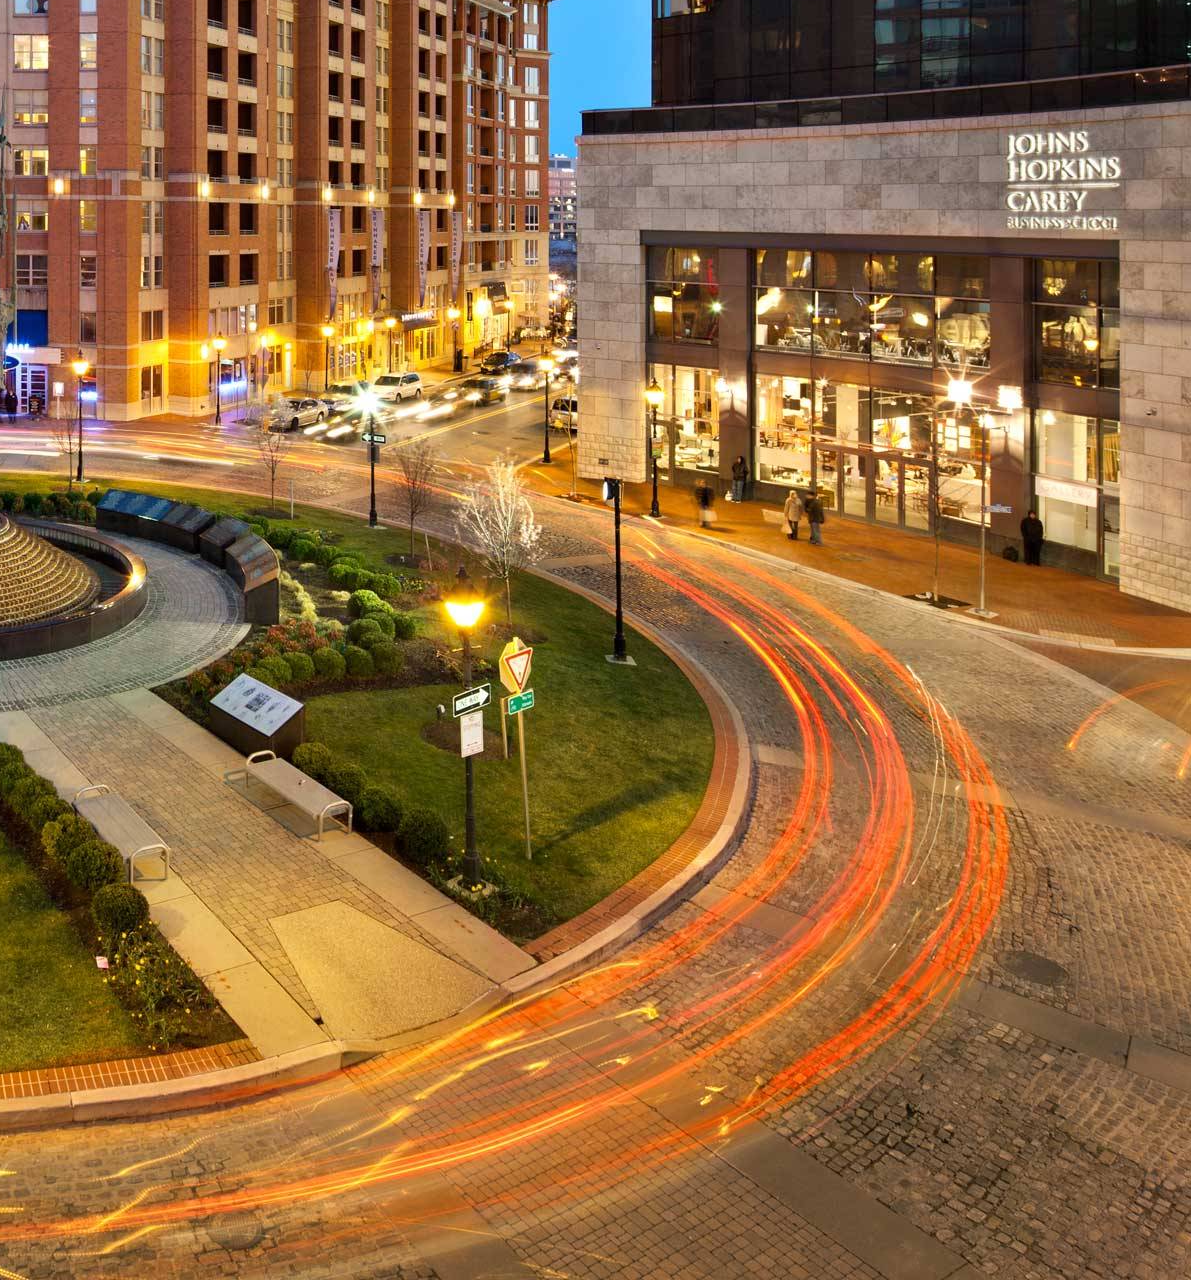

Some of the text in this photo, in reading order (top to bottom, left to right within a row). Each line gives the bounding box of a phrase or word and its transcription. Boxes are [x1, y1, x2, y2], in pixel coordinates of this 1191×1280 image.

[1007, 131, 1089, 160] JOHNS
[1008, 157, 1121, 180] HOPKINS
[1006, 191, 1087, 212] CAREY
